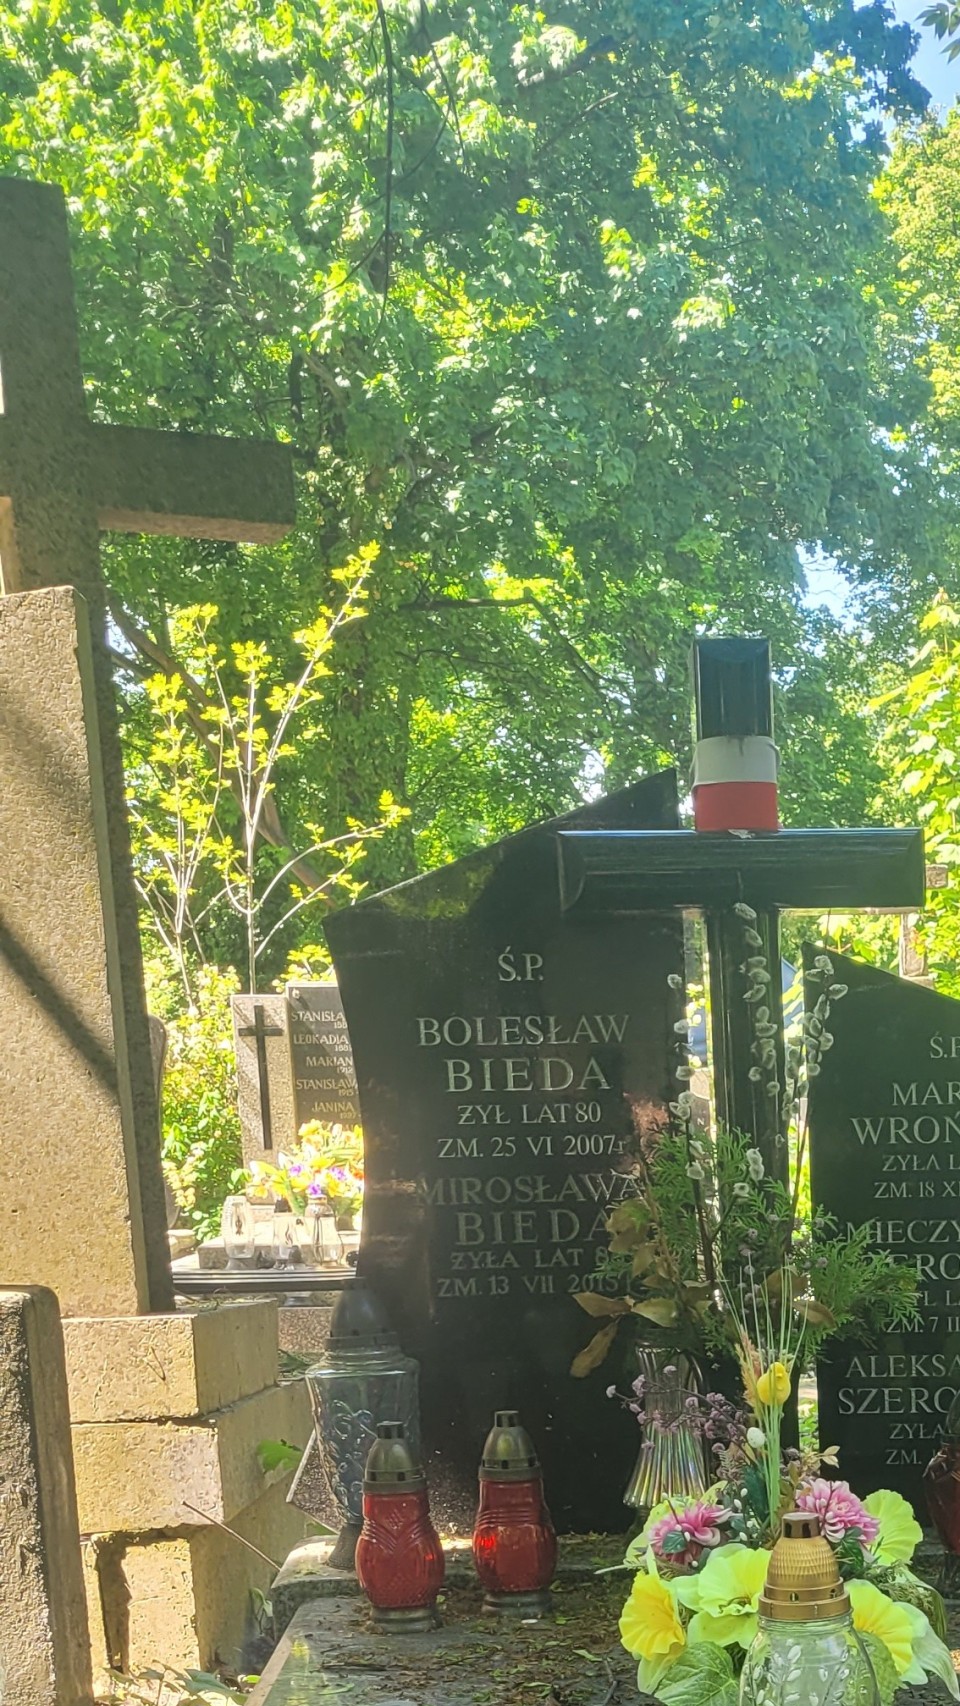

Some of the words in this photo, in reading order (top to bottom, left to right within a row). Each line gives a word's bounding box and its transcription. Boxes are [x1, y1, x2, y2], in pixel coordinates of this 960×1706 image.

[498, 946, 544, 981] Ś.P.
[292, 1011, 346, 1021] STANISŁA
[293, 1034, 349, 1045] LEOKADIA
[416, 1015, 629, 1046] BOLESŁAW
[306, 1056, 353, 1067] MARIAN
[296, 1079, 358, 1090] STANISŁAW
[444, 1057, 613, 1093] BIEDA
[312, 1102, 355, 1113] JANINA
[521, 1103, 570, 1124] LAT
[575, 1101, 601, 1123] 80
[437, 1138, 484, 1158] ZM.
[491, 1137, 516, 1157] 25
[526, 1137, 553, 1156] VI
[415, 1173, 644, 1206] MIROSŁAWA
[874, 1182, 912, 1199] ZM.
[919, 1181, 935, 1198] 18
[455, 1209, 613, 1246] BIEDA
[534, 1249, 584, 1268] LAT
[437, 1278, 483, 1298] ZM.
[489, 1276, 509, 1294] 13
[524, 1275, 553, 1294] VII
[886, 1318, 923, 1334] ZM.
[929, 1317, 938, 1332] 7
[886, 1449, 922, 1465] ZM.
